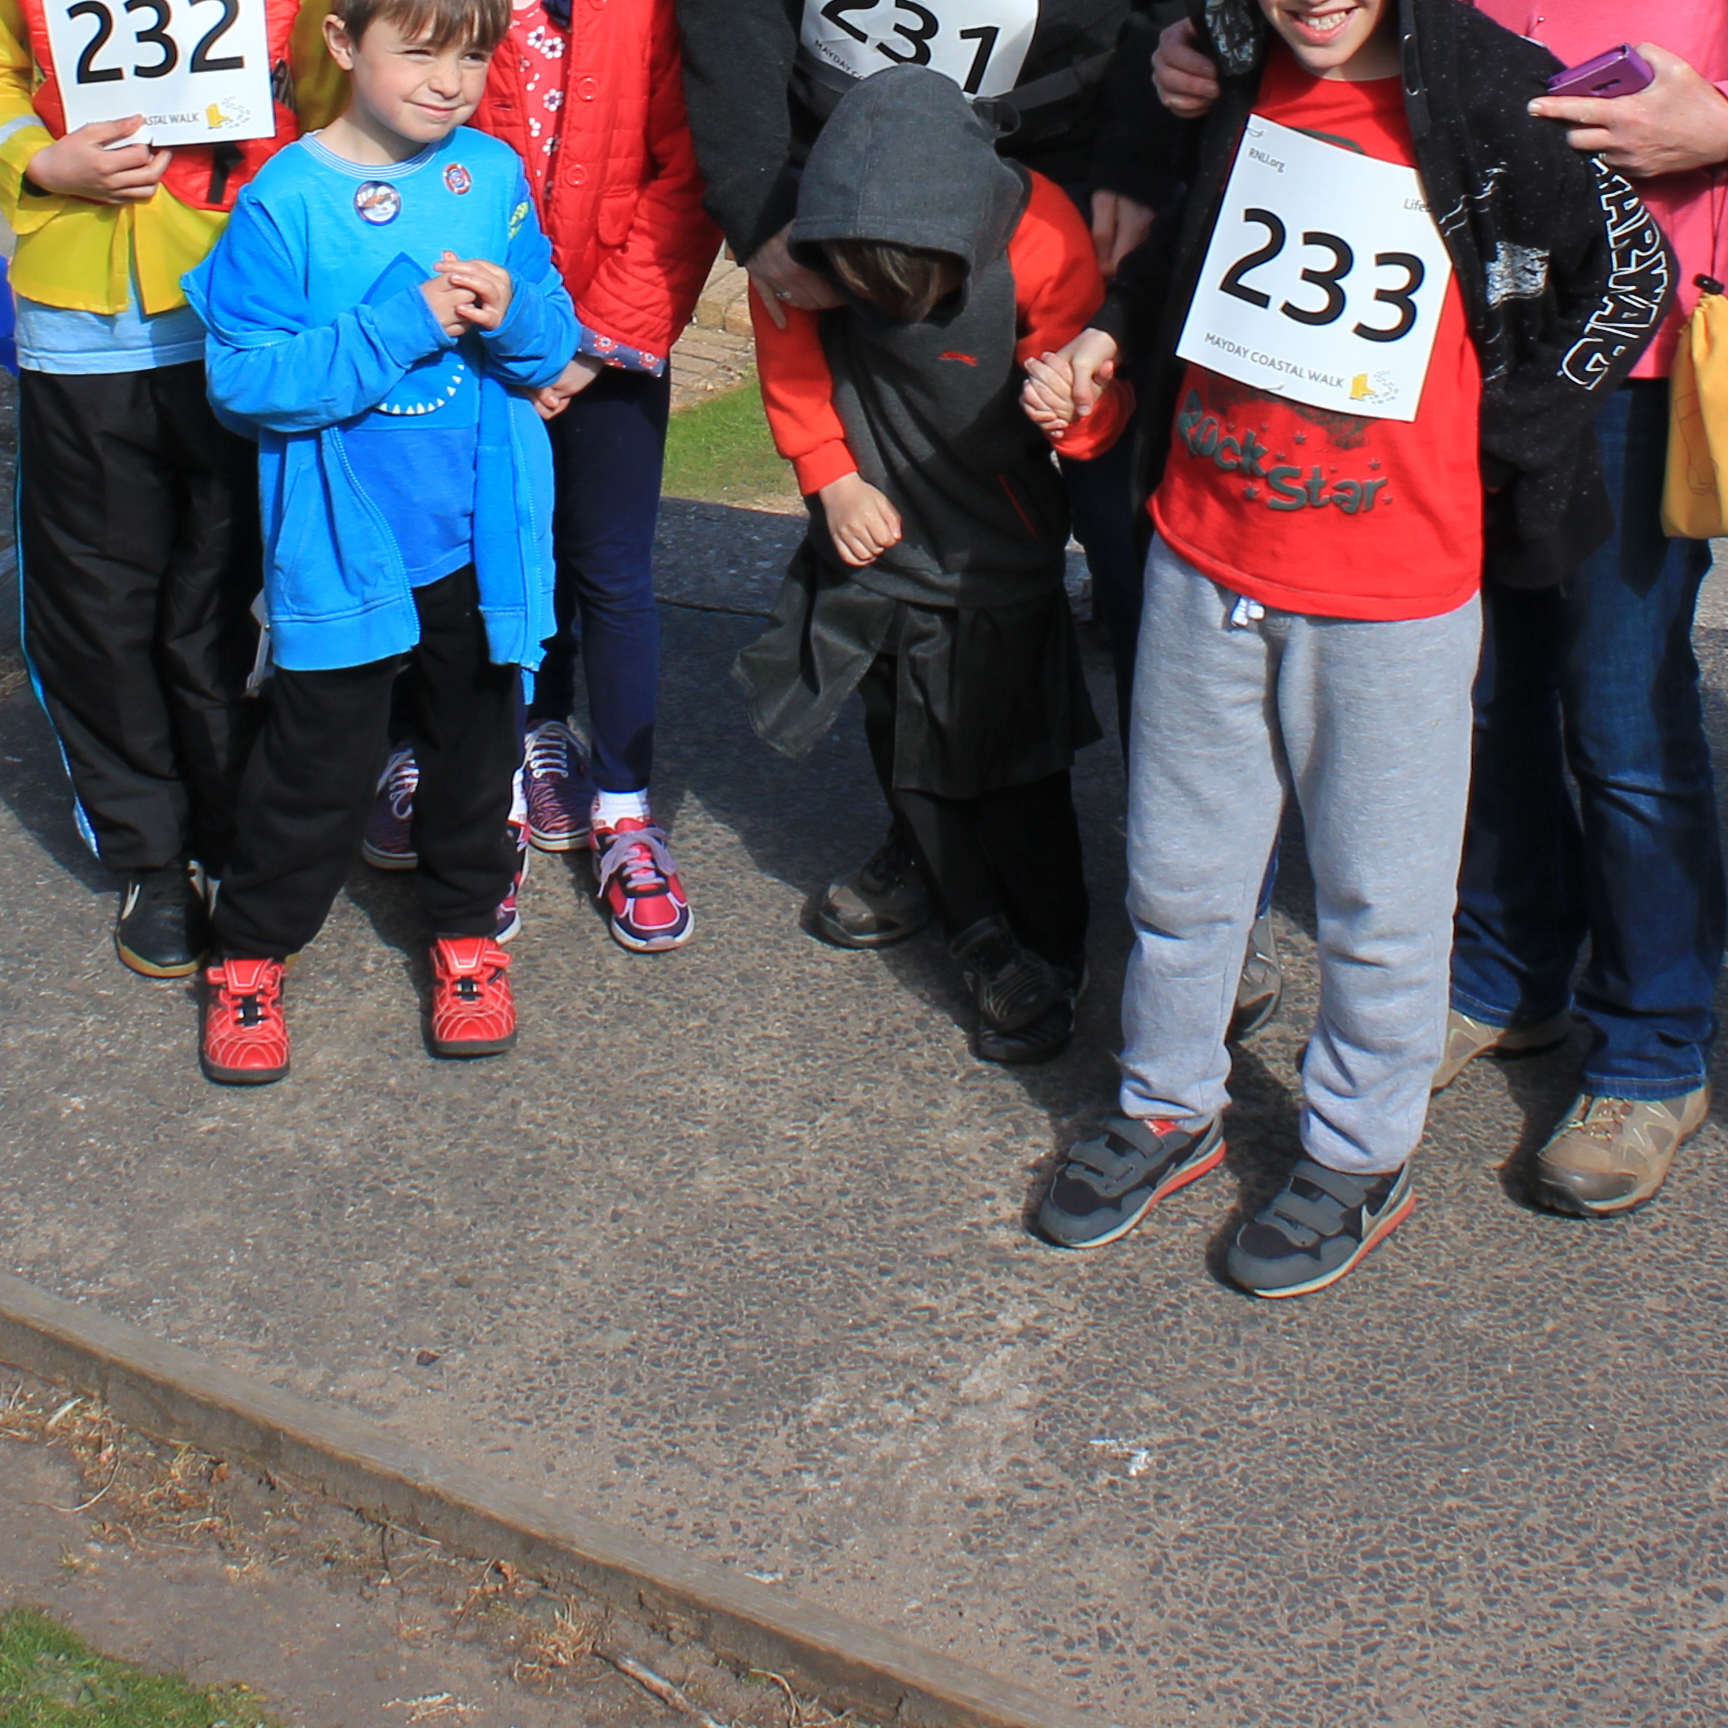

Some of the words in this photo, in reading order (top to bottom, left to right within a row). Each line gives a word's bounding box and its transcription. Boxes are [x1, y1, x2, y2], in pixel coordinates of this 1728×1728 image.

[168, 112, 200, 125] WALK
[1247, 147, 1287, 174] RNLI.org
[1218, 207, 1426, 343] 233
[1204, 331, 1250, 360] MAYDAY
[1250, 350, 1306, 380] COASTAL
[1307, 369, 1346, 389] WALK
[1177, 387, 1269, 478] Rock
[1267, 464, 1388, 515] Star
